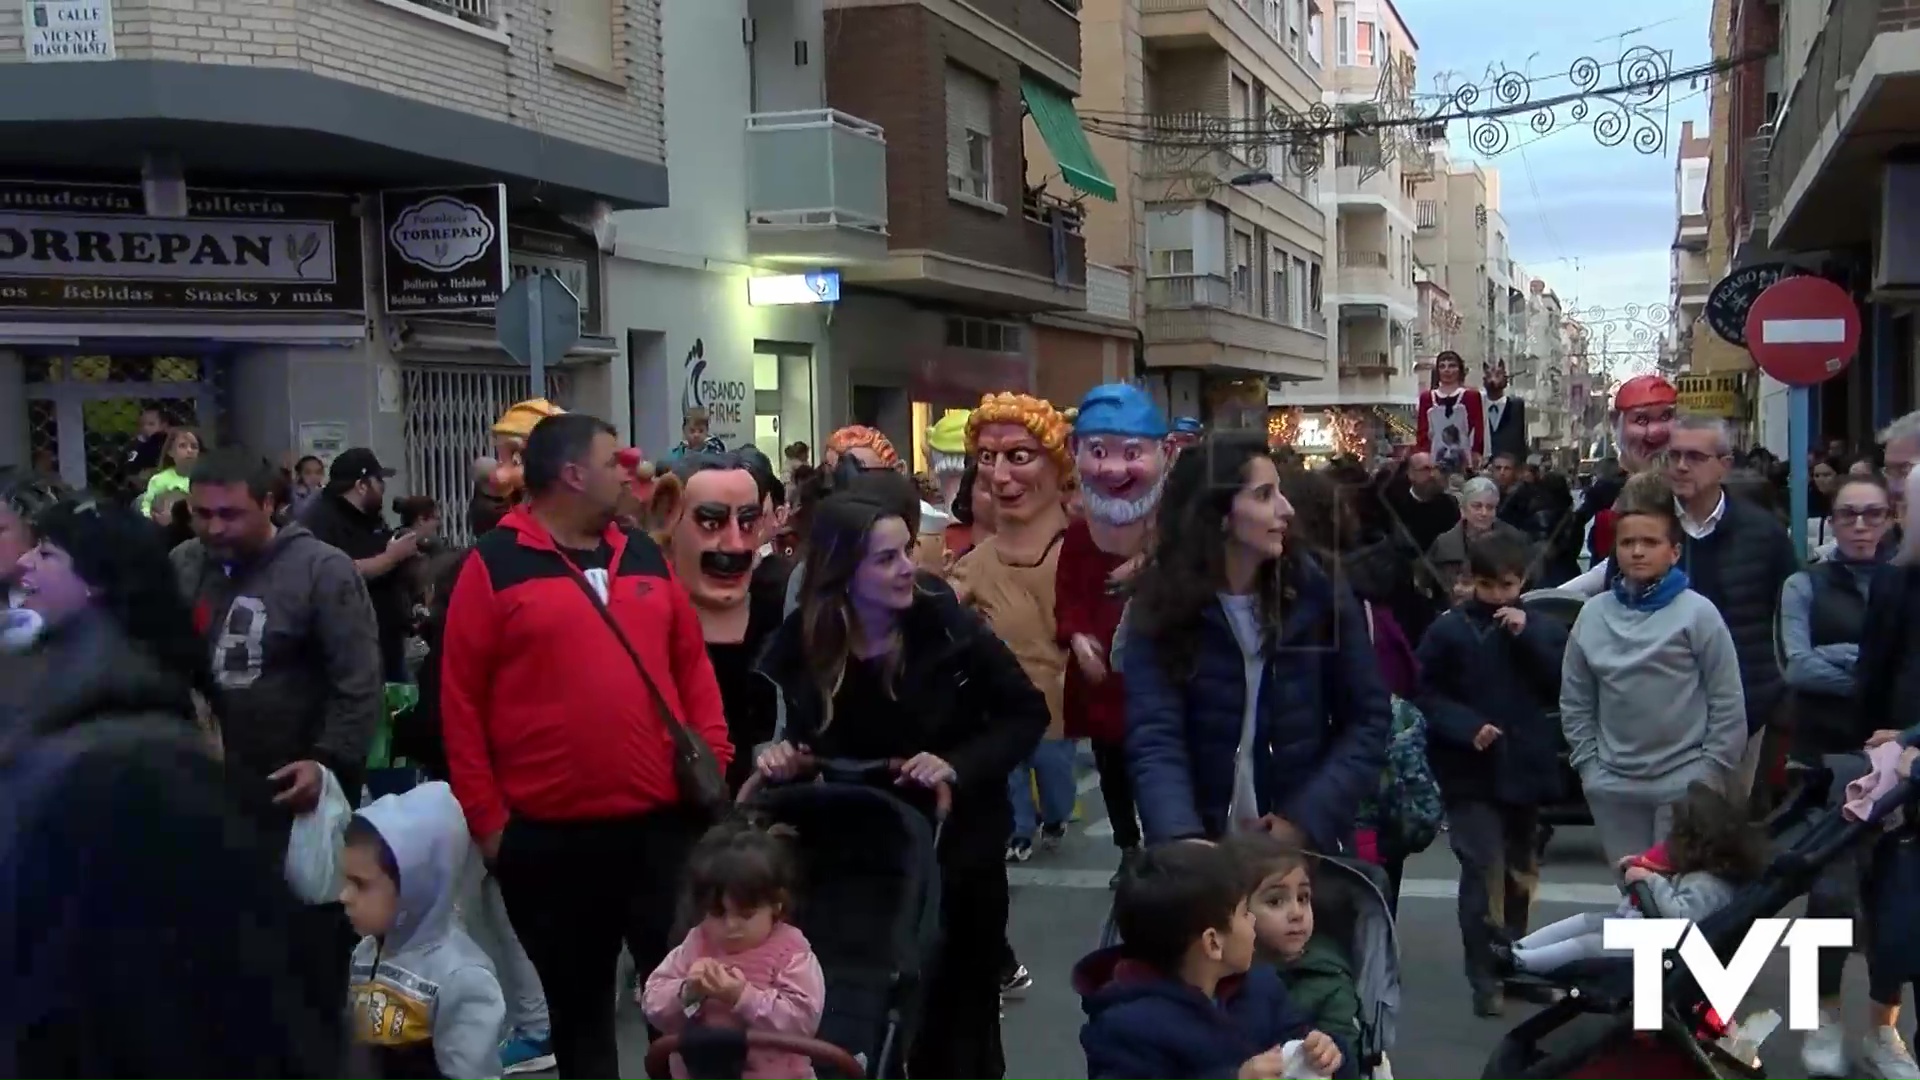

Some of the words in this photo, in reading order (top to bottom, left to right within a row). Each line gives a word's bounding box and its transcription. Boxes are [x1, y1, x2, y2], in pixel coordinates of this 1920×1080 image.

[58, 7, 99, 21] CALLE
[42, 29, 98, 42] VICENTE
[33, 43, 69, 56] BLASCO
[401, 227, 482, 241] TORREPAN
[450, 277, 487, 288] Helados
[1713, 270, 1757, 308] FIGARO
[63, 285, 153, 300] Bebidas
[185, 287, 258, 302] Snacks
[269, 291, 281, 304] y
[292, 288, 333, 302] más
[438, 292, 468, 304] Snacks
[472, 295, 479, 305] y
[702, 380, 745, 401] PISANDO
[708, 402, 741, 423] FIRME
